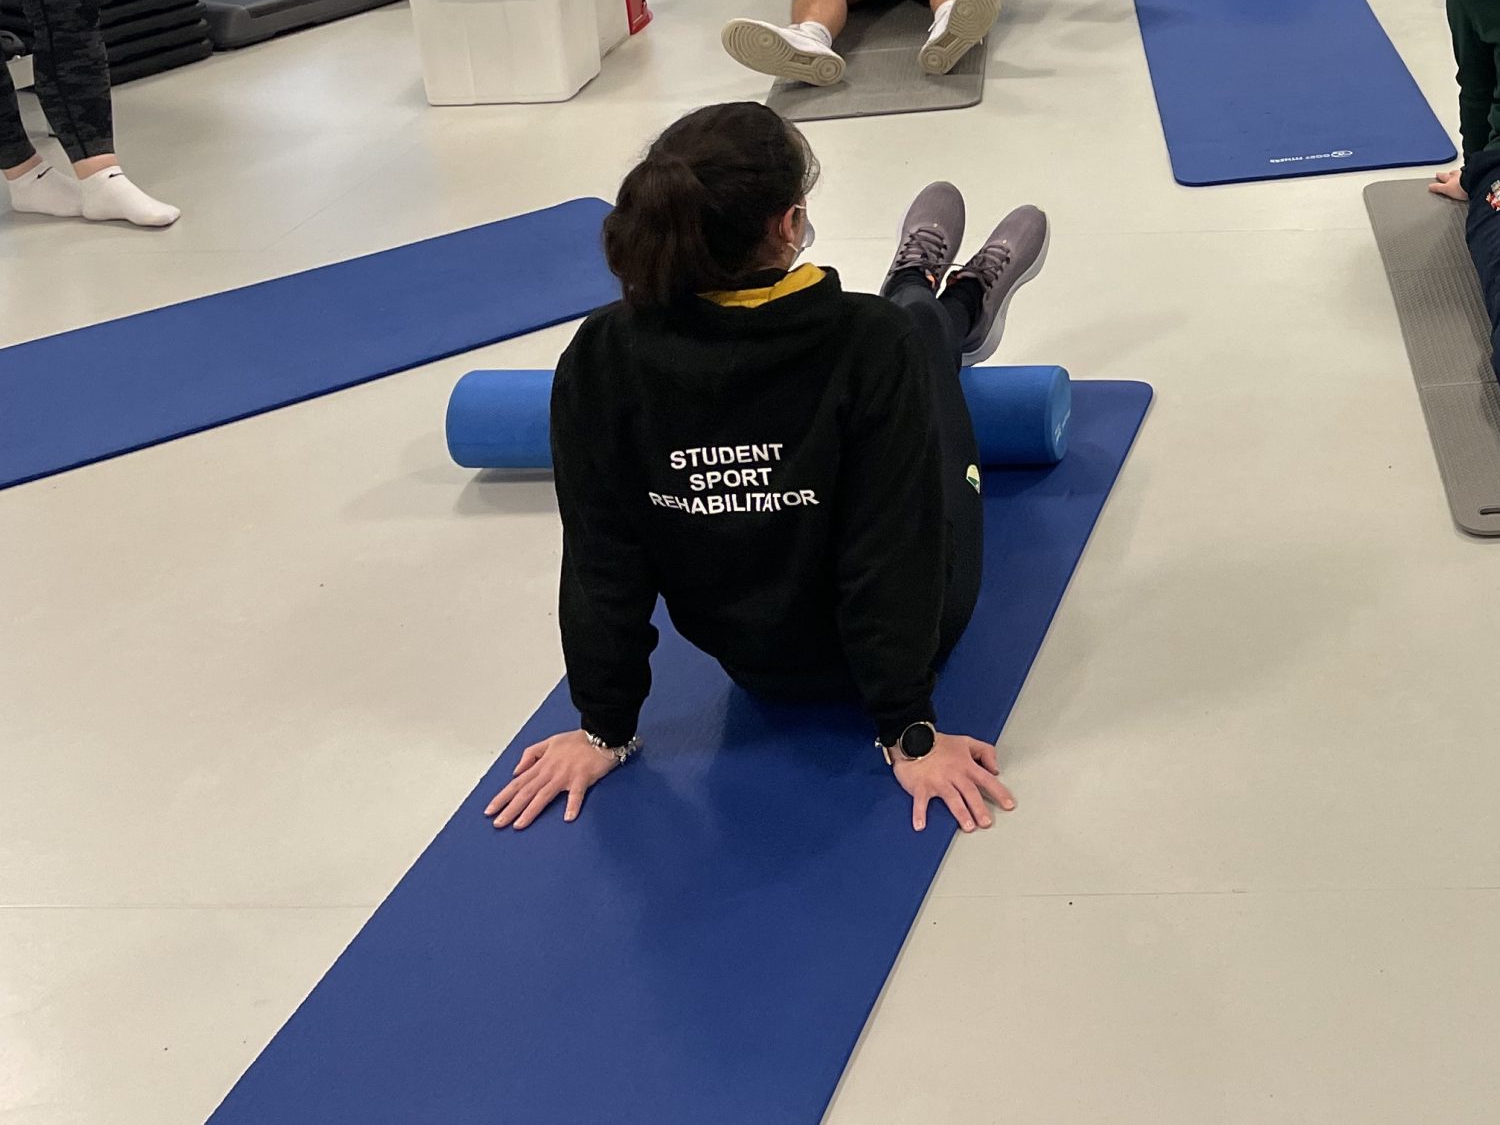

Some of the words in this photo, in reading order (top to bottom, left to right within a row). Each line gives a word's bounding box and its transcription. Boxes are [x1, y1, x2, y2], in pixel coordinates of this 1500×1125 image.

[670, 443, 784, 470] STUDENT
[689, 467, 773, 492] SPORT
[648, 488, 820, 516] REHABILITATOR
